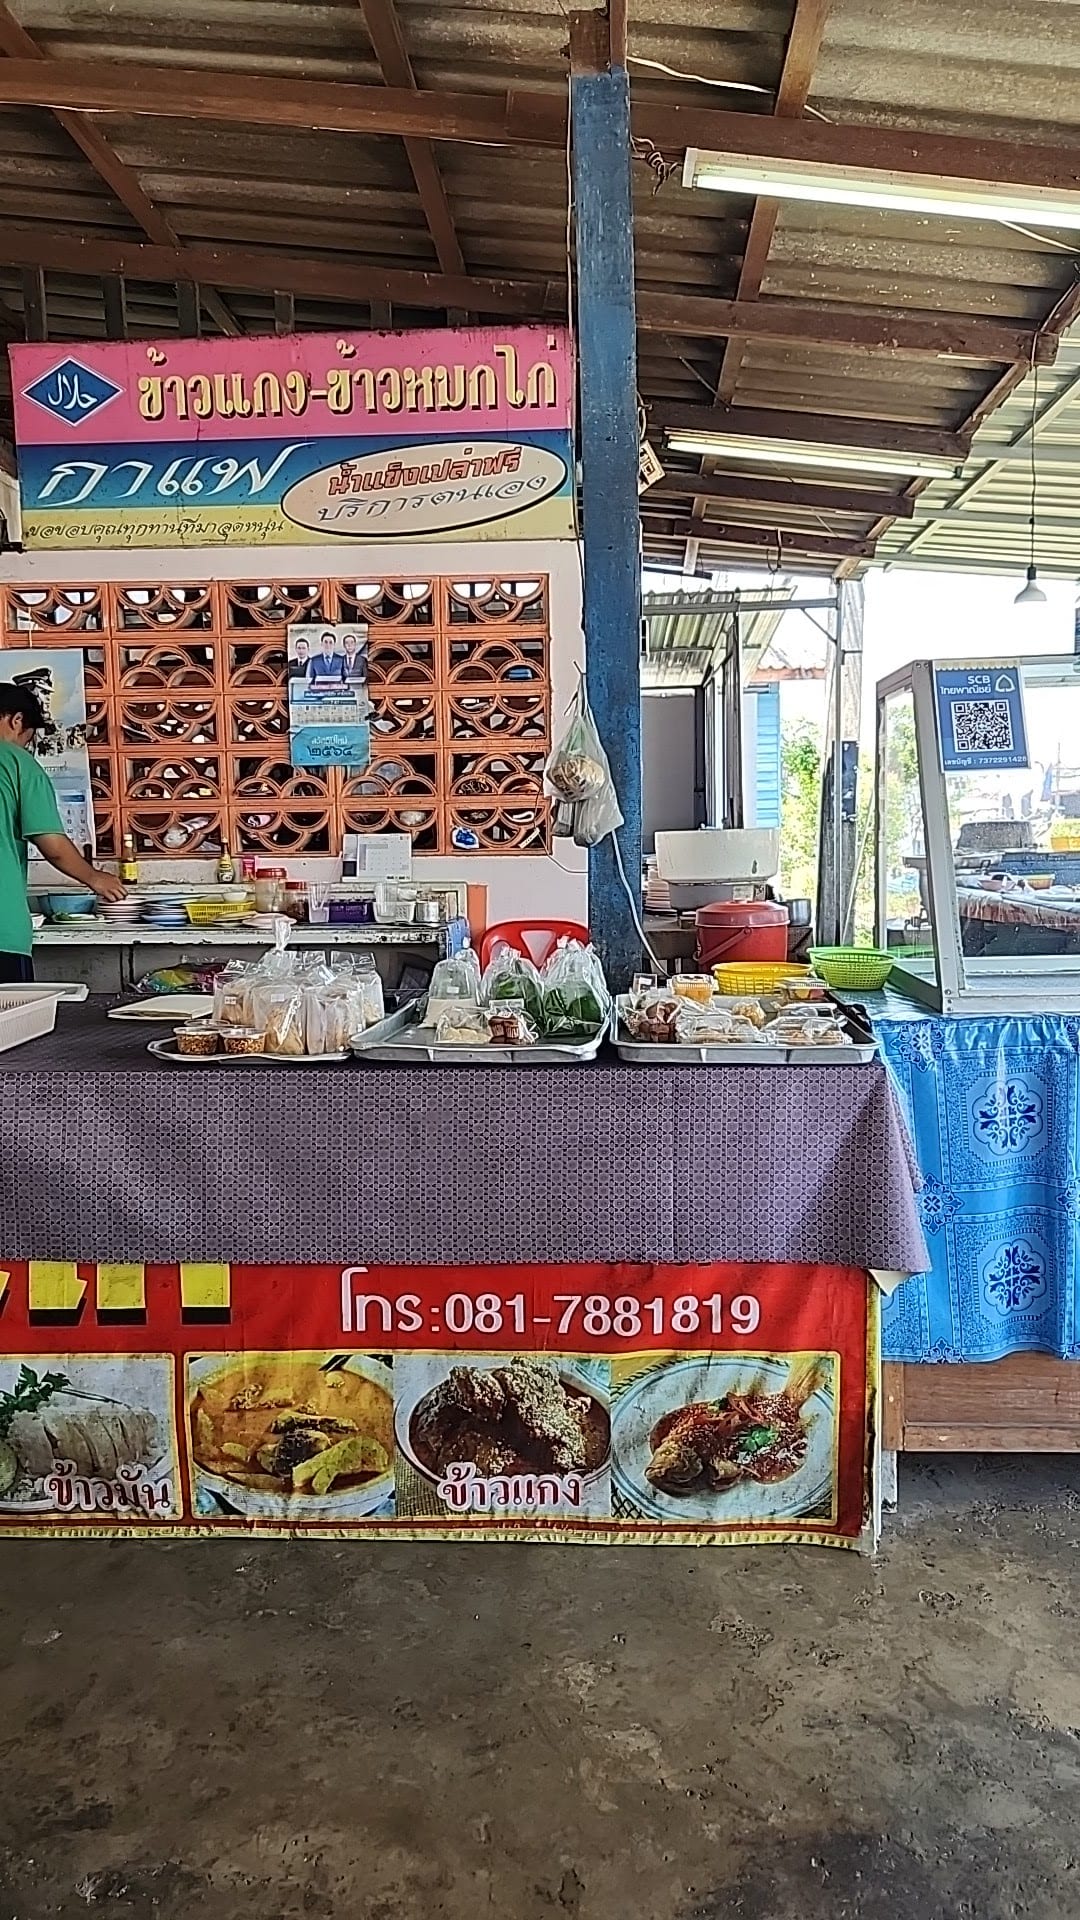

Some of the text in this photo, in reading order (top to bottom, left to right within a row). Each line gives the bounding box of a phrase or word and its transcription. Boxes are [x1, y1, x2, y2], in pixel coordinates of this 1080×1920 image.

[47, 372, 98, 410] حلال
[137, 334, 559, 421] ข้าวแกง-ข้าวหมกไก่
[37, 441, 317, 507] กาแฟ
[327, 446, 522, 496] น้ำแข็งเปล่าฟรี
[317, 474, 548, 522] บริการตนเอง
[27, 513, 285, 543] ขอขอบคุณทุกท่านที่มาอุดหนุน
[939, 684, 992, 695] ไทยพาณิชย์
[967, 675, 991, 684] SCB
[48, 1462, 172, 1510] ข้าวมัน
[441, 1465, 581, 1508] ข้าวแกง
